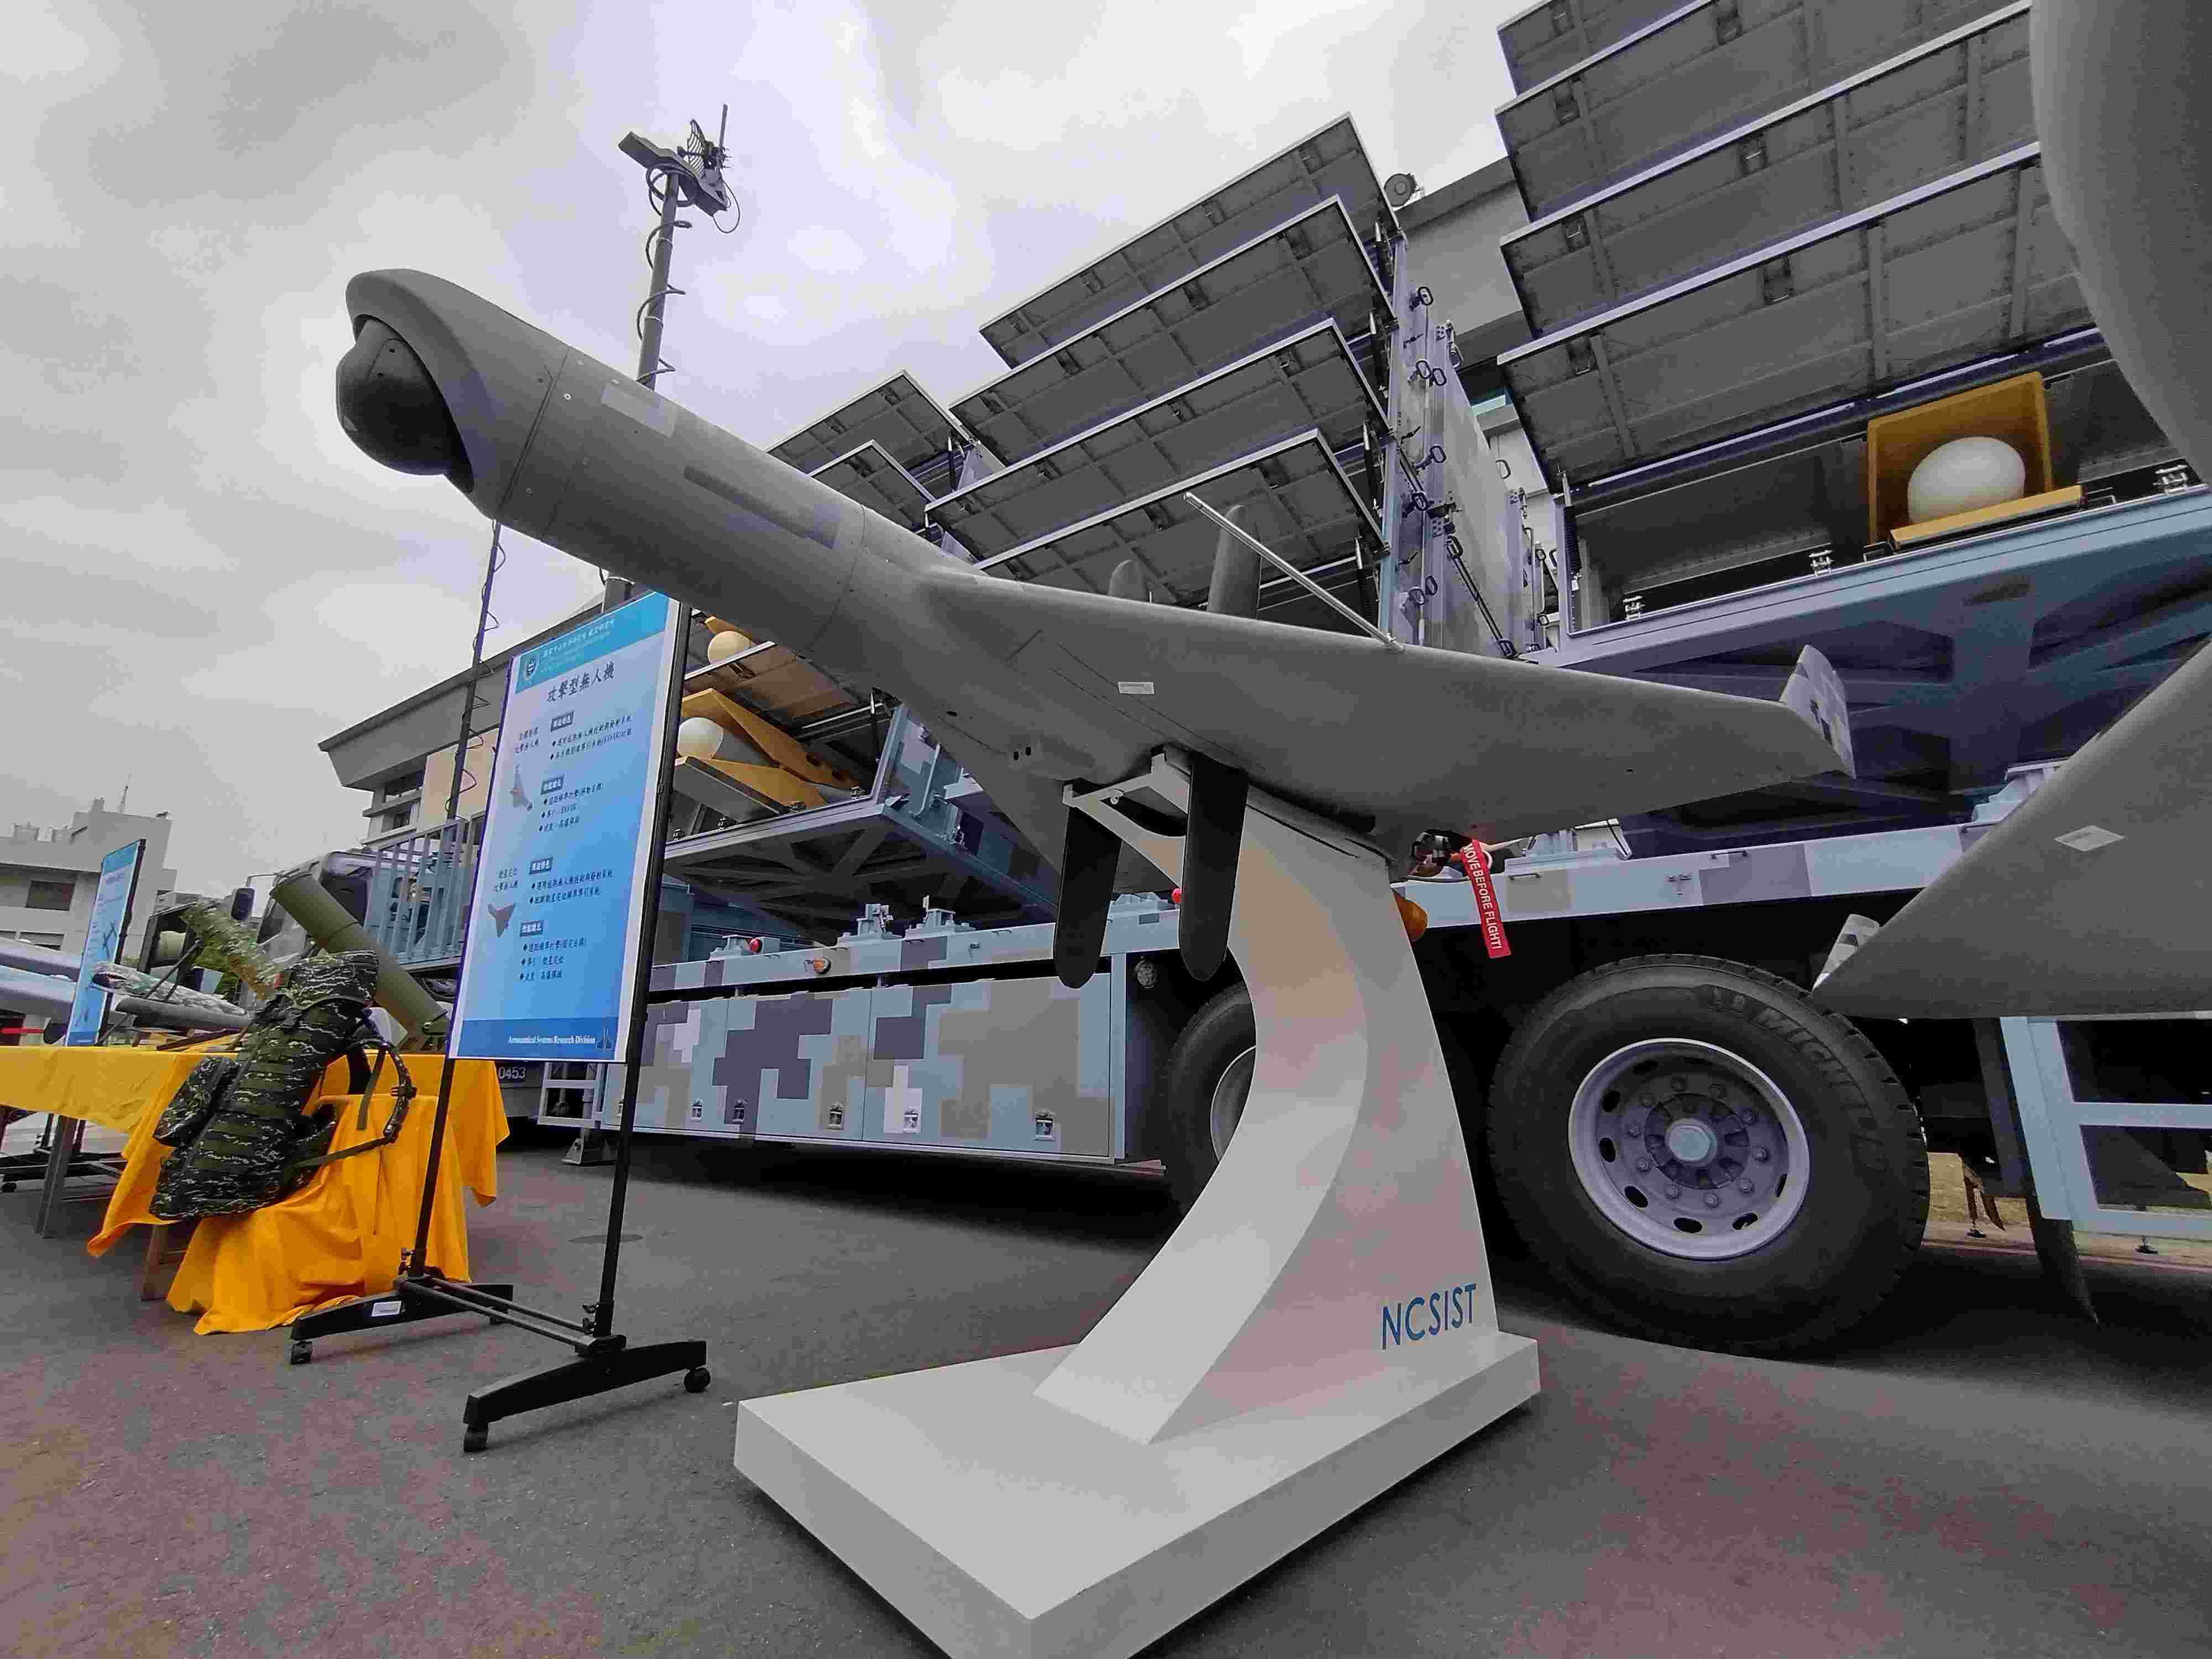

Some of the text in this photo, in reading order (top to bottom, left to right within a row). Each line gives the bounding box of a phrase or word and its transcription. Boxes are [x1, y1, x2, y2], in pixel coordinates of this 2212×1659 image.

[1473, 869, 1493, 910] BEFORE
[575, 1035, 596, 1044] Division
[498, 1066, 526, 1079] 0453
[1381, 1282, 1477, 1350] NCSIST
